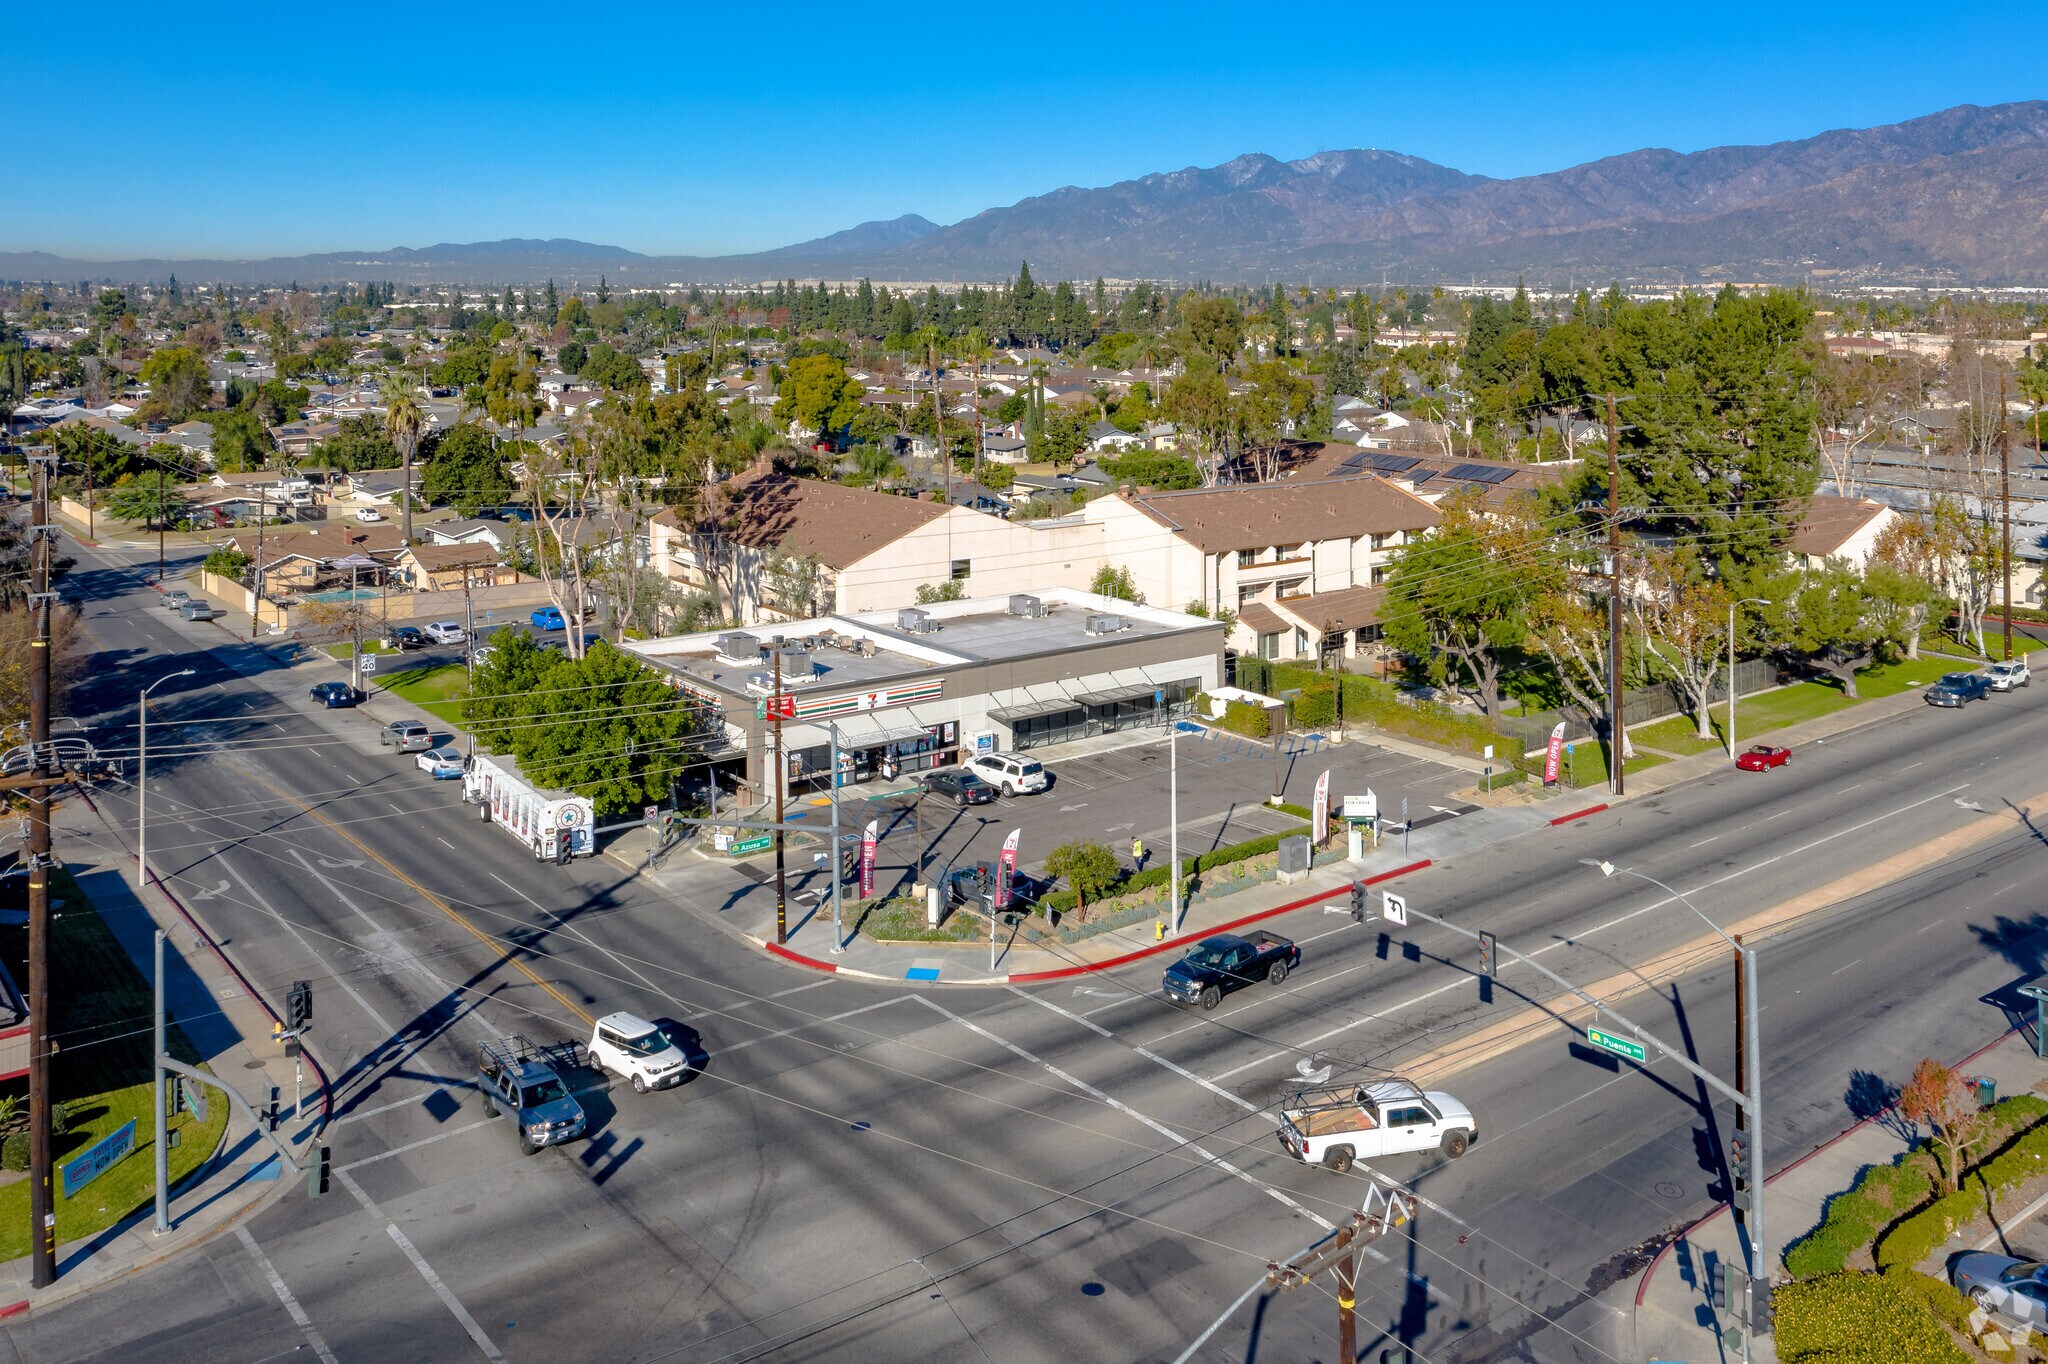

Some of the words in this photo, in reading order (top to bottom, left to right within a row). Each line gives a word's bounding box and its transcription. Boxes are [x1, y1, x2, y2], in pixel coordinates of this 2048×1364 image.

[362, 662, 375, 670] 40
[1550, 740, 1560, 759] OPEN
[1548, 759, 1557, 777] NOW
[740, 842, 761, 851] Azusa
[1603, 1036, 1632, 1055] Puente
[93, 1141, 110, 1160] PATIO
[111, 1127, 130, 1147] DINING
[95, 1151, 111, 1173] NOW
[112, 1139, 129, 1160] OPEN
